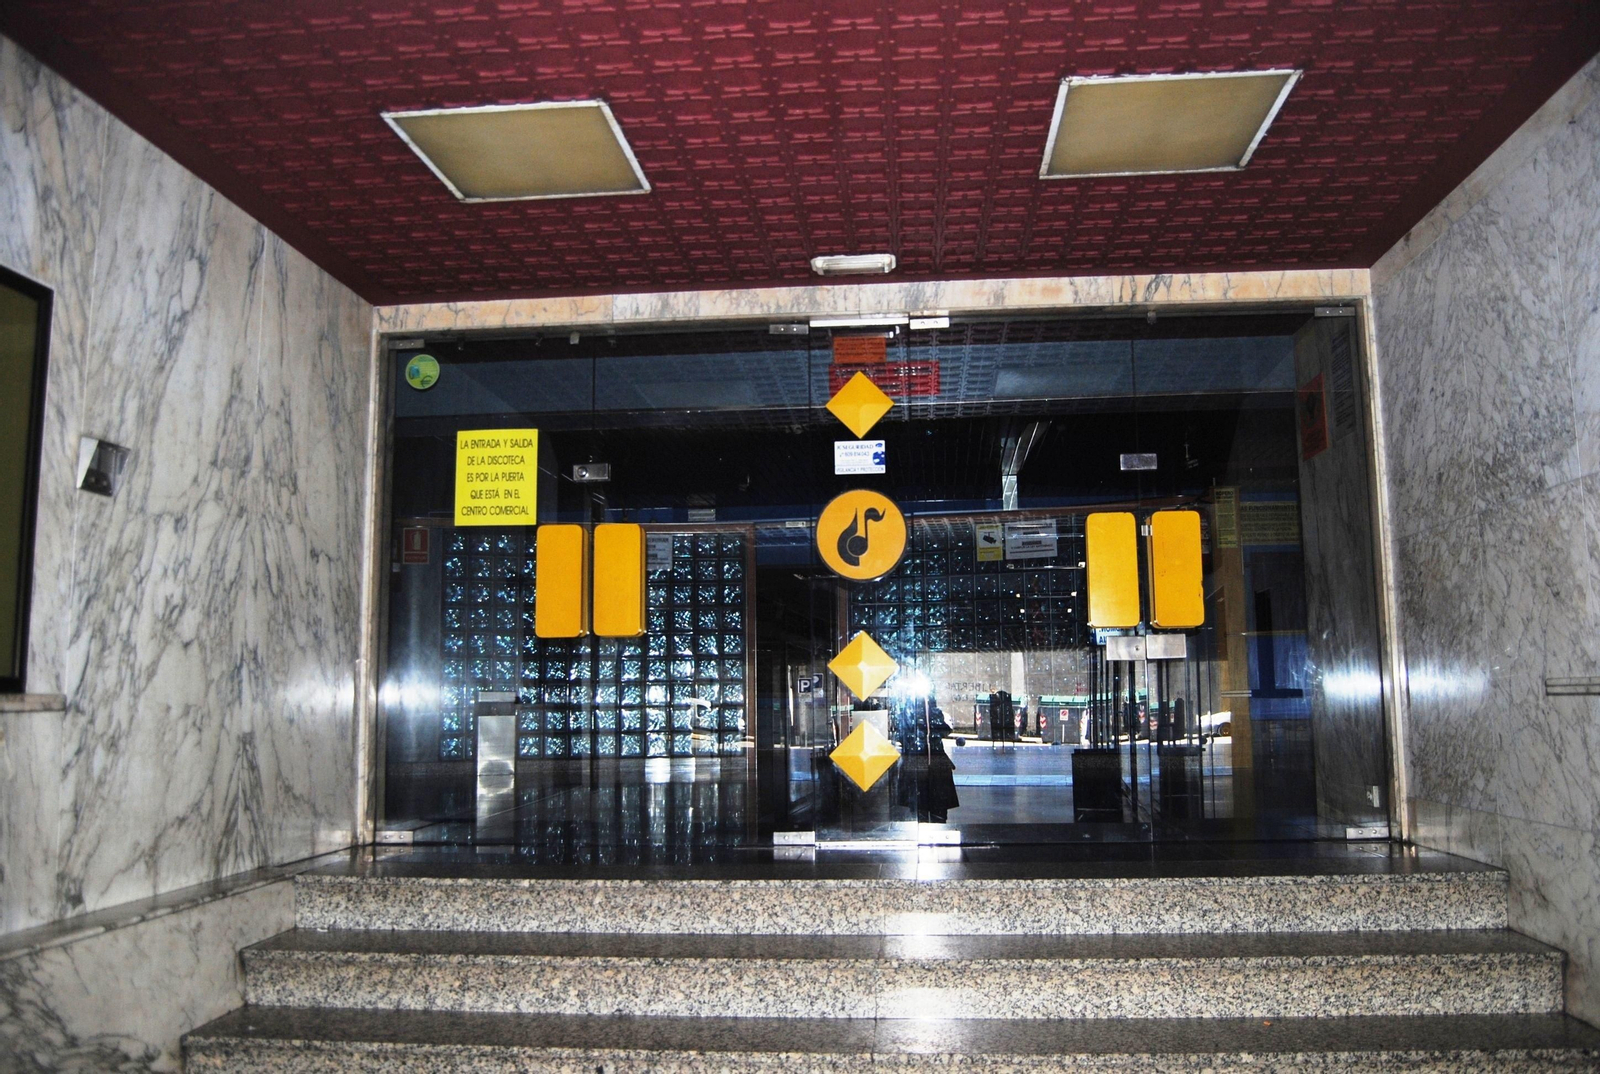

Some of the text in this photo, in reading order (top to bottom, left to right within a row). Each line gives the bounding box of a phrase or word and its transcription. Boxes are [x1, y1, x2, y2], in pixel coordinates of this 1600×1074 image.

[460, 438, 533, 449] LA ENTRADA Y SALIDA
[467, 455, 525, 465] DE LA DISCOTECA
[467, 472, 524, 482] ES POR LA PUERTA
[470, 488, 520, 499] QUE ESTÁ EN EL
[461, 505, 529, 516] CENTRO COMERCIAL
[800, 680, 811, 692] P
